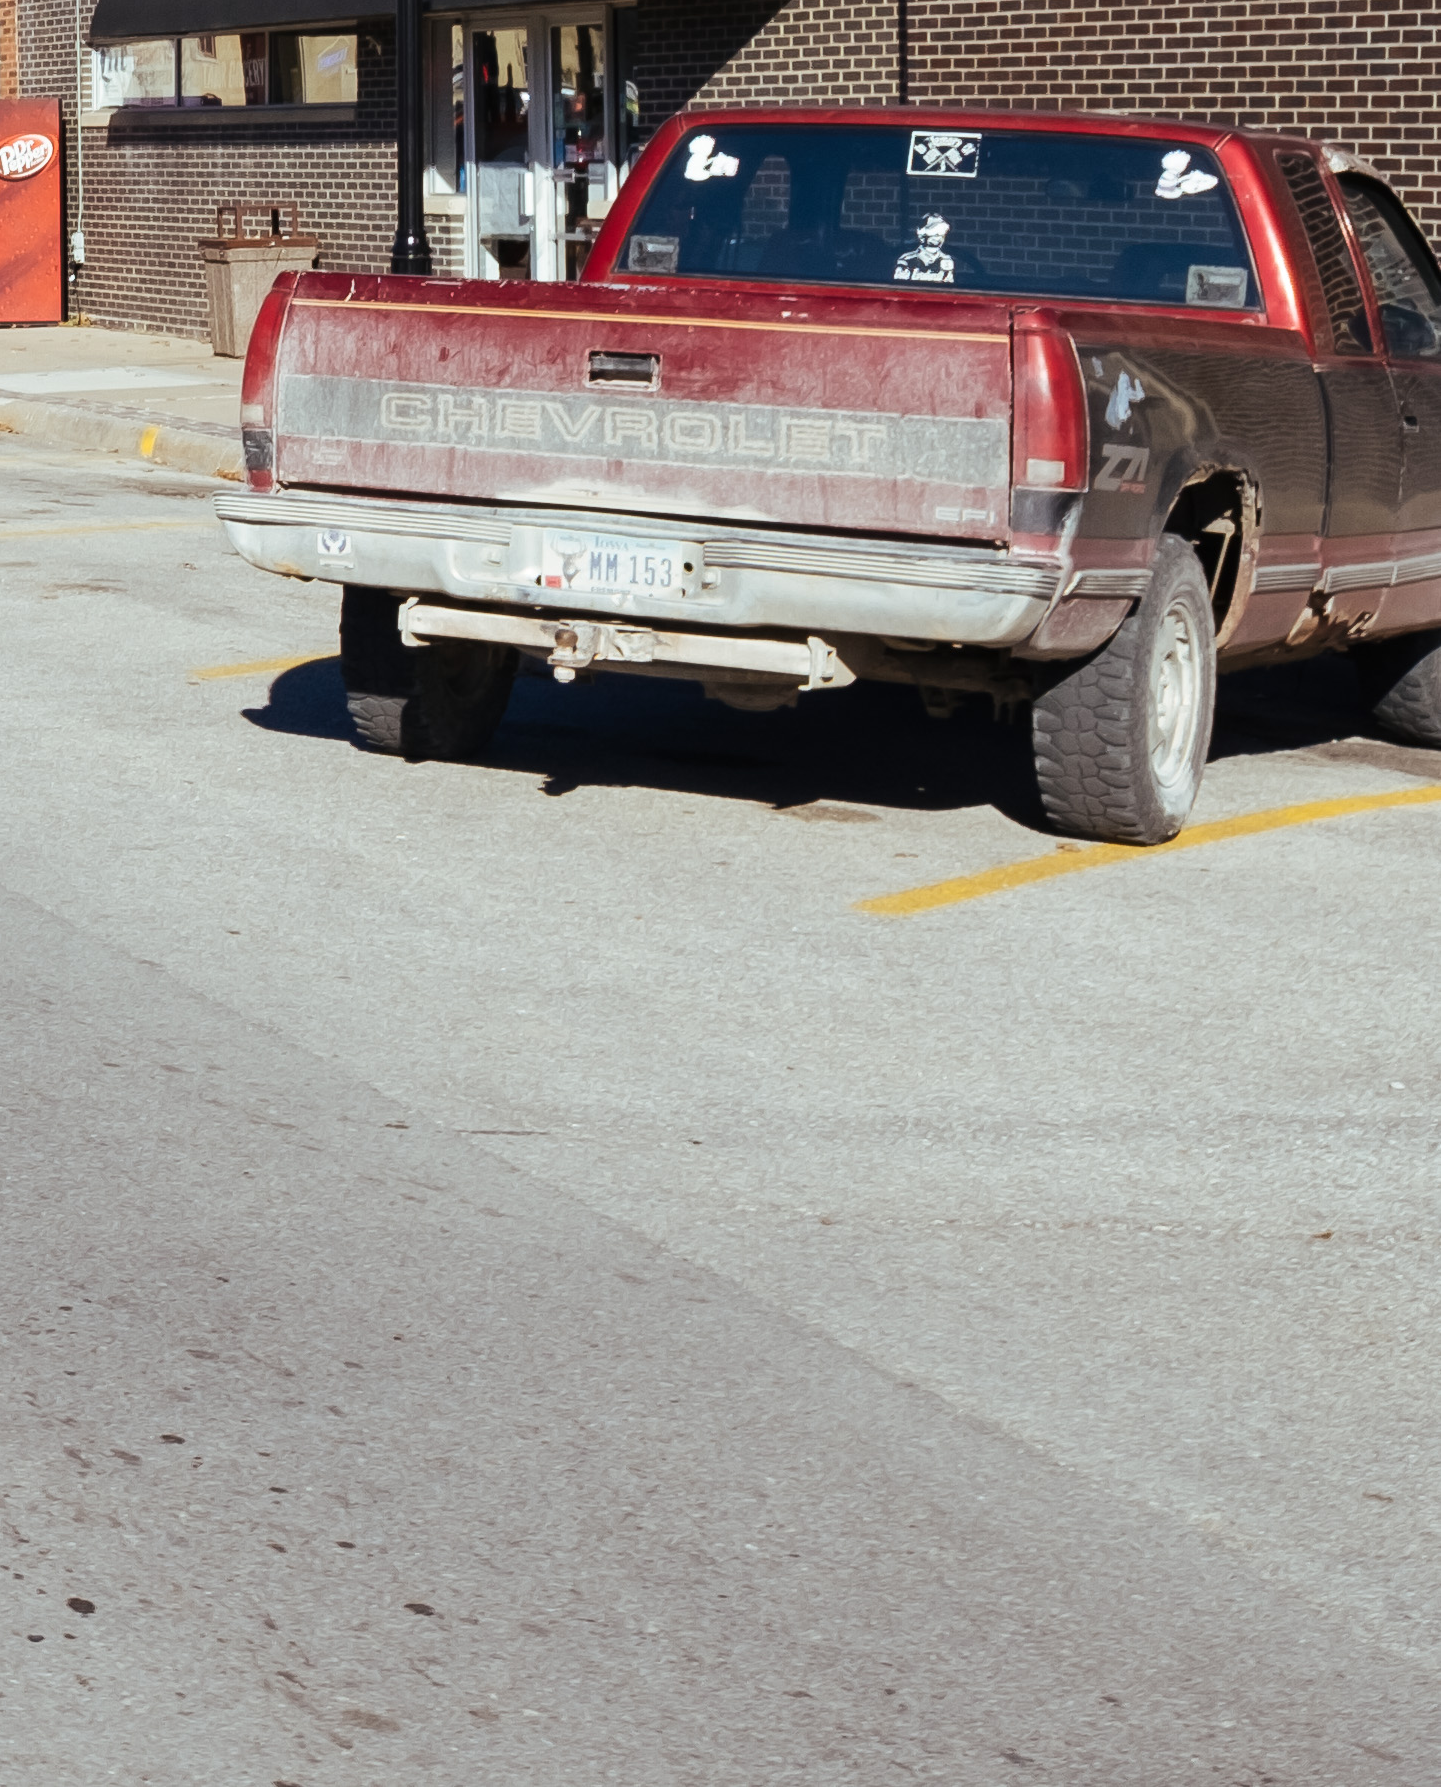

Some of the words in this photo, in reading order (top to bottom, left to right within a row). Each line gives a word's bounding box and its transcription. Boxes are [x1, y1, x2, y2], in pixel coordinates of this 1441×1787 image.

[12, 139, 35, 155] Dr
[379, 391, 889, 463] CHEVROLET
[1094, 443, 1151, 492] Z71
[589, 551, 618, 583] MM
[629, 555, 673, 587] 153
